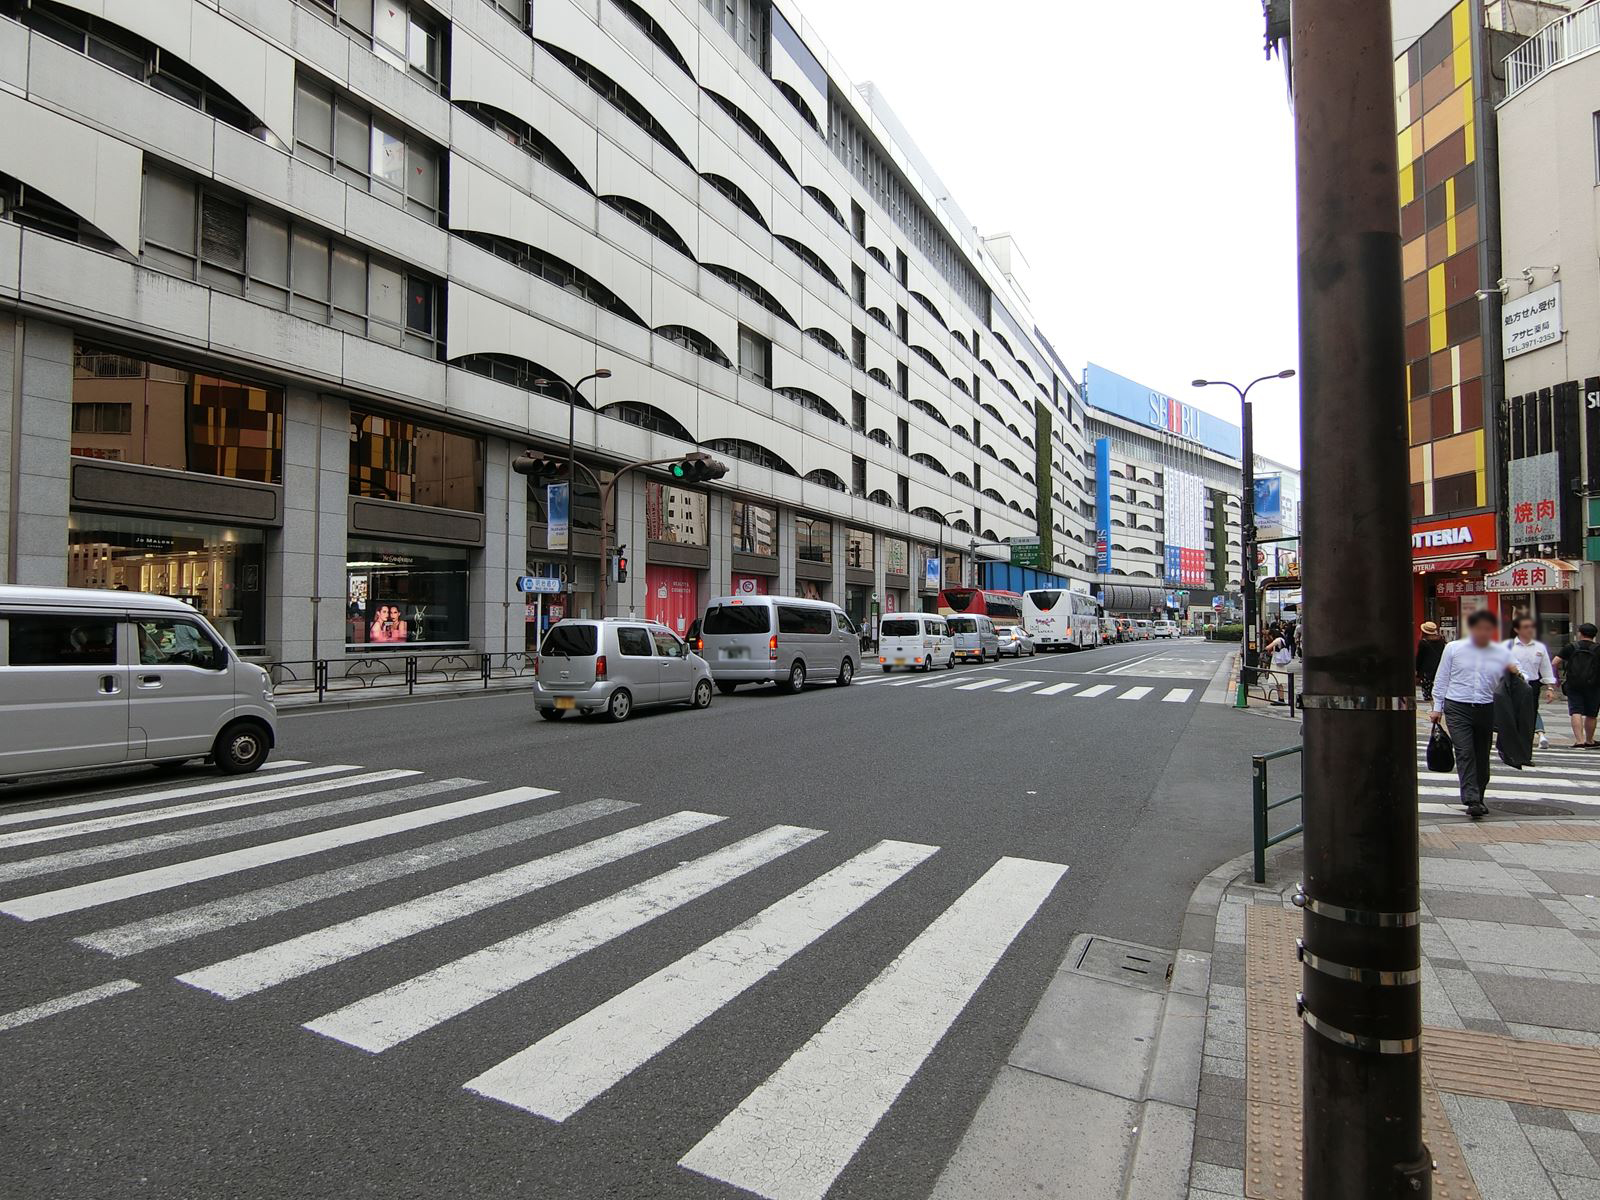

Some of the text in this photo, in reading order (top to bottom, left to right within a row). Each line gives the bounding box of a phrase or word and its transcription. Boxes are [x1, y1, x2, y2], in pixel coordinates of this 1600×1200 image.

[1505, 297, 1556, 326] 処方せん受付
[1511, 321, 1550, 342] アサヒ薬局
[1149, 392, 1200, 440] SEIBU
[1514, 499, 1555, 524] 焼肉
[1097, 529, 1107, 568] SEIBU
[1412, 527, 1472, 548] TTERIA
[1490, 579, 1499, 587] 2F
[1512, 567, 1546, 587] 焼肉
